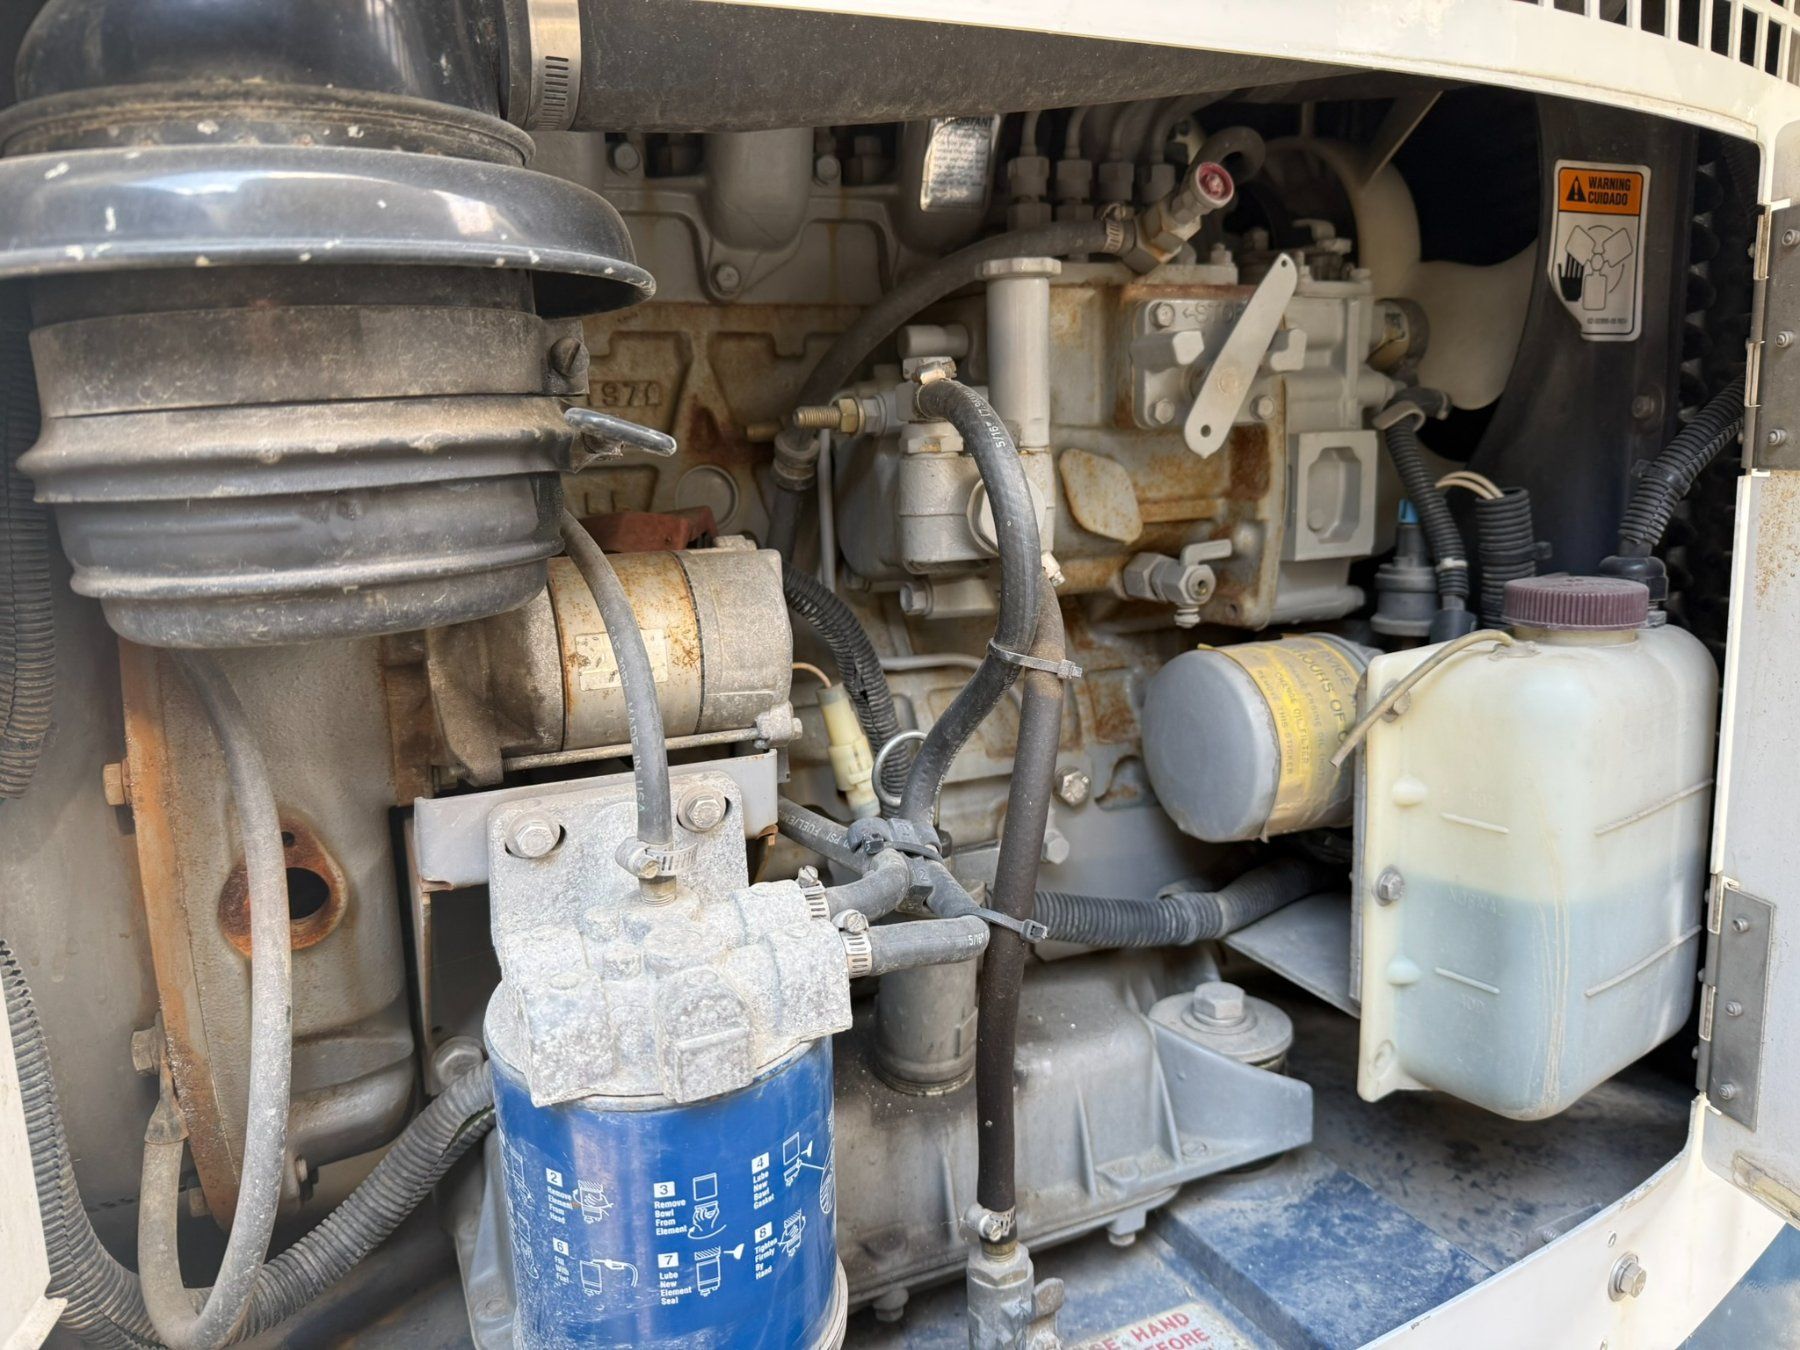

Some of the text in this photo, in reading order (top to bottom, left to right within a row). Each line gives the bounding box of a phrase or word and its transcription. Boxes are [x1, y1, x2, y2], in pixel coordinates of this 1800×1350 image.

[1588, 176, 1631, 191] WARNING
[1587, 191, 1628, 206] CUIDADO
[627, 702, 640, 747] MADE
[634, 755, 642, 771] IN
[826, 831, 842, 845] PSI
[753, 1171, 769, 1184] Lube
[753, 1181, 768, 1194] New
[753, 1187, 770, 1202] Bowl
[654, 1199, 687, 1210] Remove
[753, 1193, 775, 1211] Gasket
[655, 1209, 675, 1219] Bowl
[655, 1217, 676, 1227] From
[656, 1225, 688, 1237] Element
[754, 1238, 778, 1256] Tighten
[755, 1247, 775, 1263] Firmly
[755, 1262, 764, 1273] By
[755, 1265, 773, 1280] Hand
[659, 1271, 679, 1280] Lube
[660, 1280, 678, 1289] New
[660, 1286, 692, 1298] Element
[661, 1296, 679, 1306] Seal
[1130, 1312, 1190, 1342] HAND
[1144, 1327, 1211, 1350] EFORE
